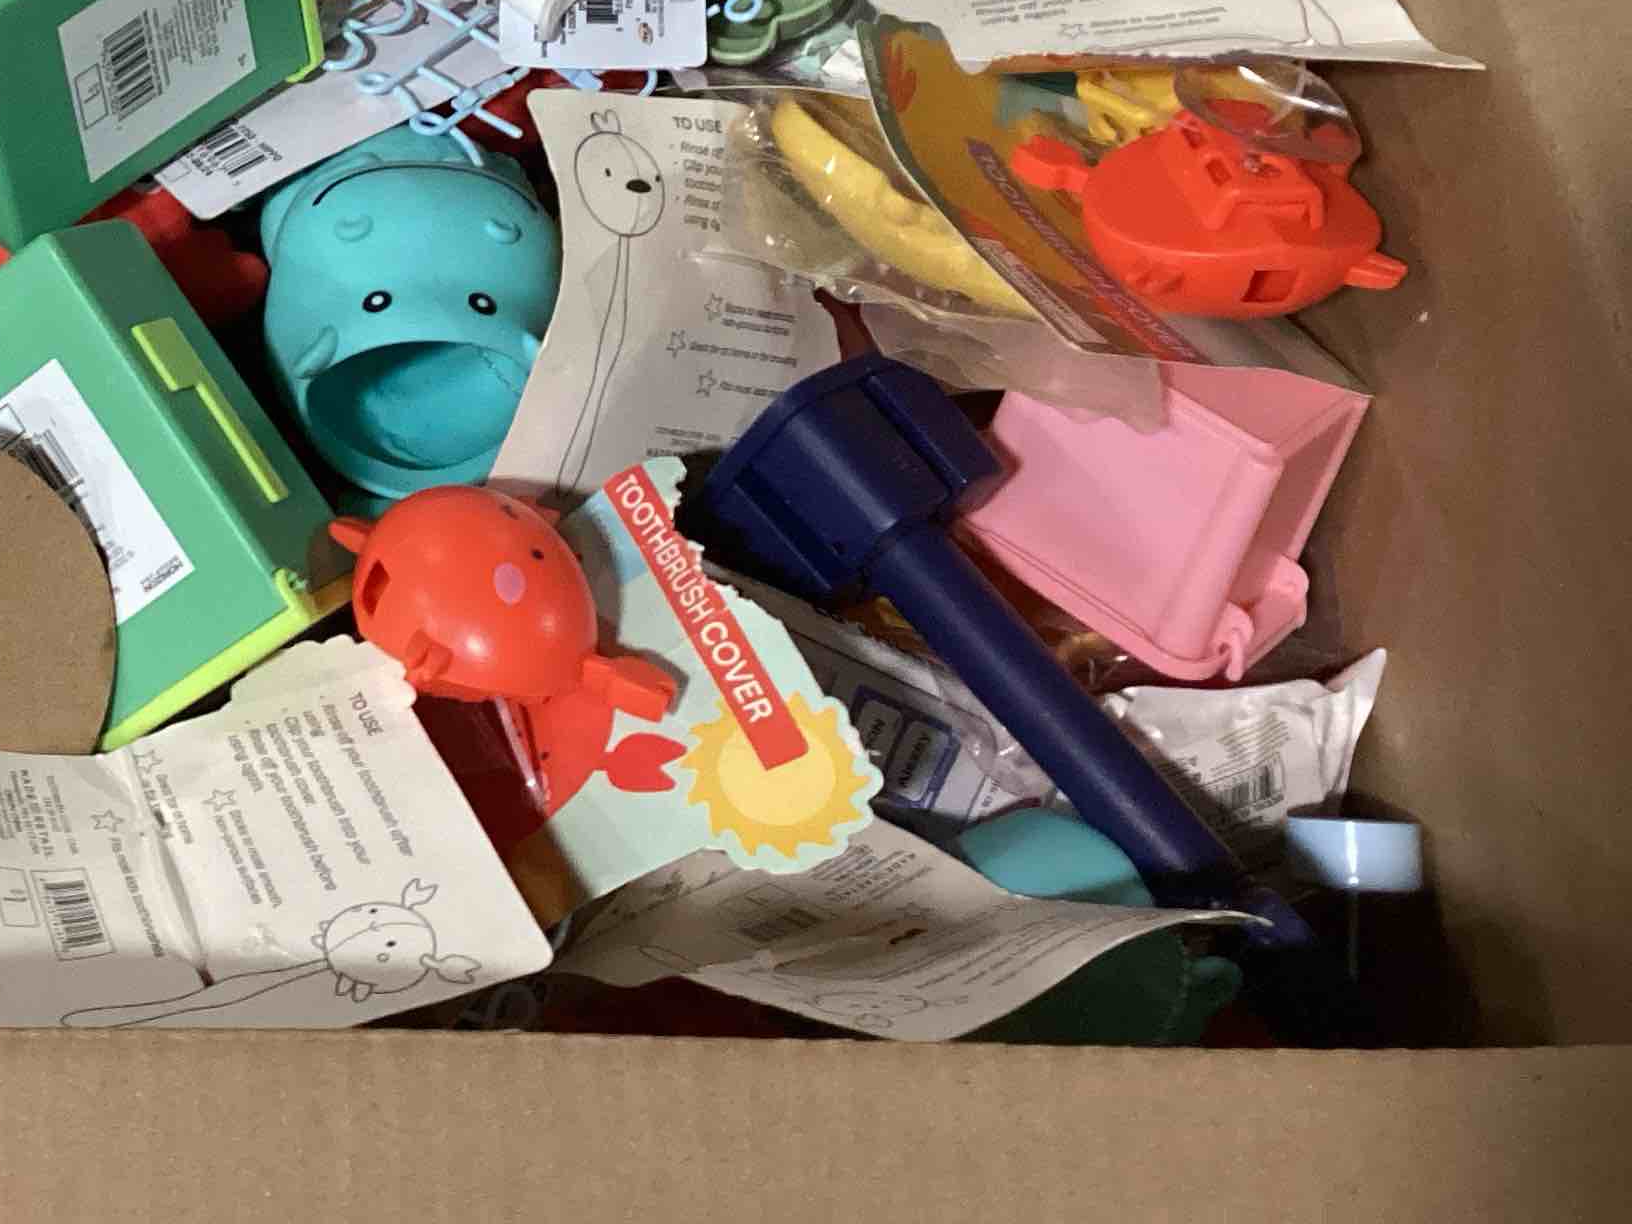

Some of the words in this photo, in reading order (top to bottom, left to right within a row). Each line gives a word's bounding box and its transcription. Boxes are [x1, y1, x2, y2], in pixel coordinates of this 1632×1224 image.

[672, 116, 693, 131] TO
[694, 118, 723, 134] USE
[615, 473, 716, 625] TOOTHBRUSH
[699, 621, 773, 724] COVER
[348, 690, 368, 711] TO
[359, 709, 385, 737] USE
[307, 759, 347, 817] toothbrush
[357, 767, 400, 829] toothbrush
[280, 793, 320, 854] toothbrush
